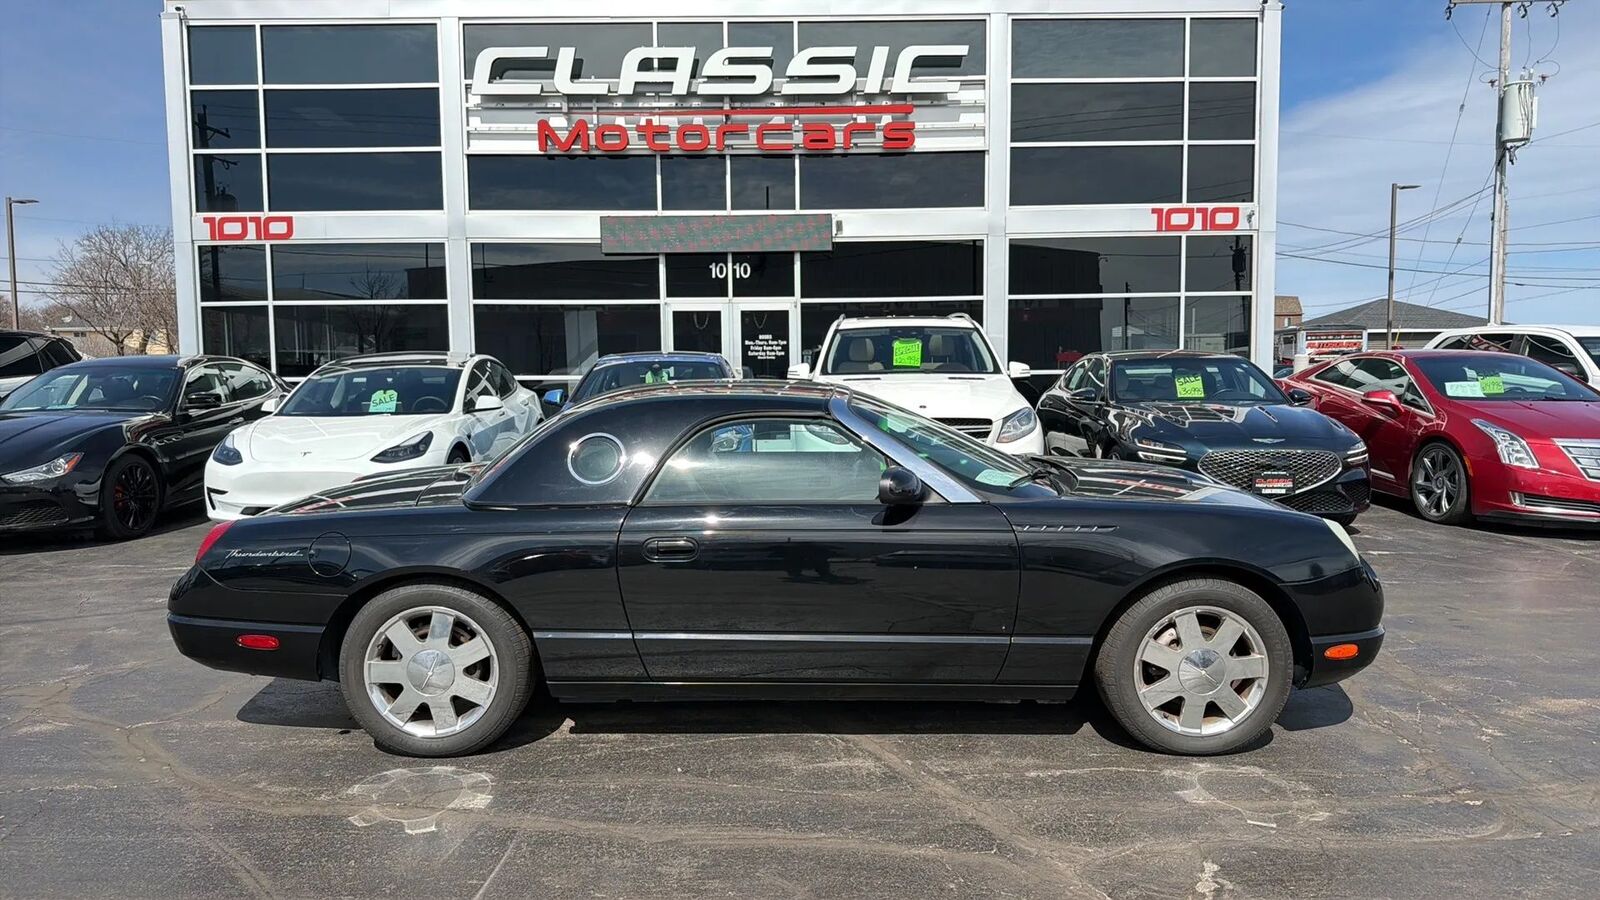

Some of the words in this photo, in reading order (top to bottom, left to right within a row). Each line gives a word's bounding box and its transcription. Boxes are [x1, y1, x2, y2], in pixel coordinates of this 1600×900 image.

[471, 45, 970, 95] CLASSIC
[537, 118, 916, 152] Motorcars
[203, 216, 293, 240] 1010
[1151, 207, 1240, 232] 1010
[1177, 374, 1201, 386] SALE
[372, 393, 396, 408] SALE
[224, 549, 304, 560] Thunderbird
